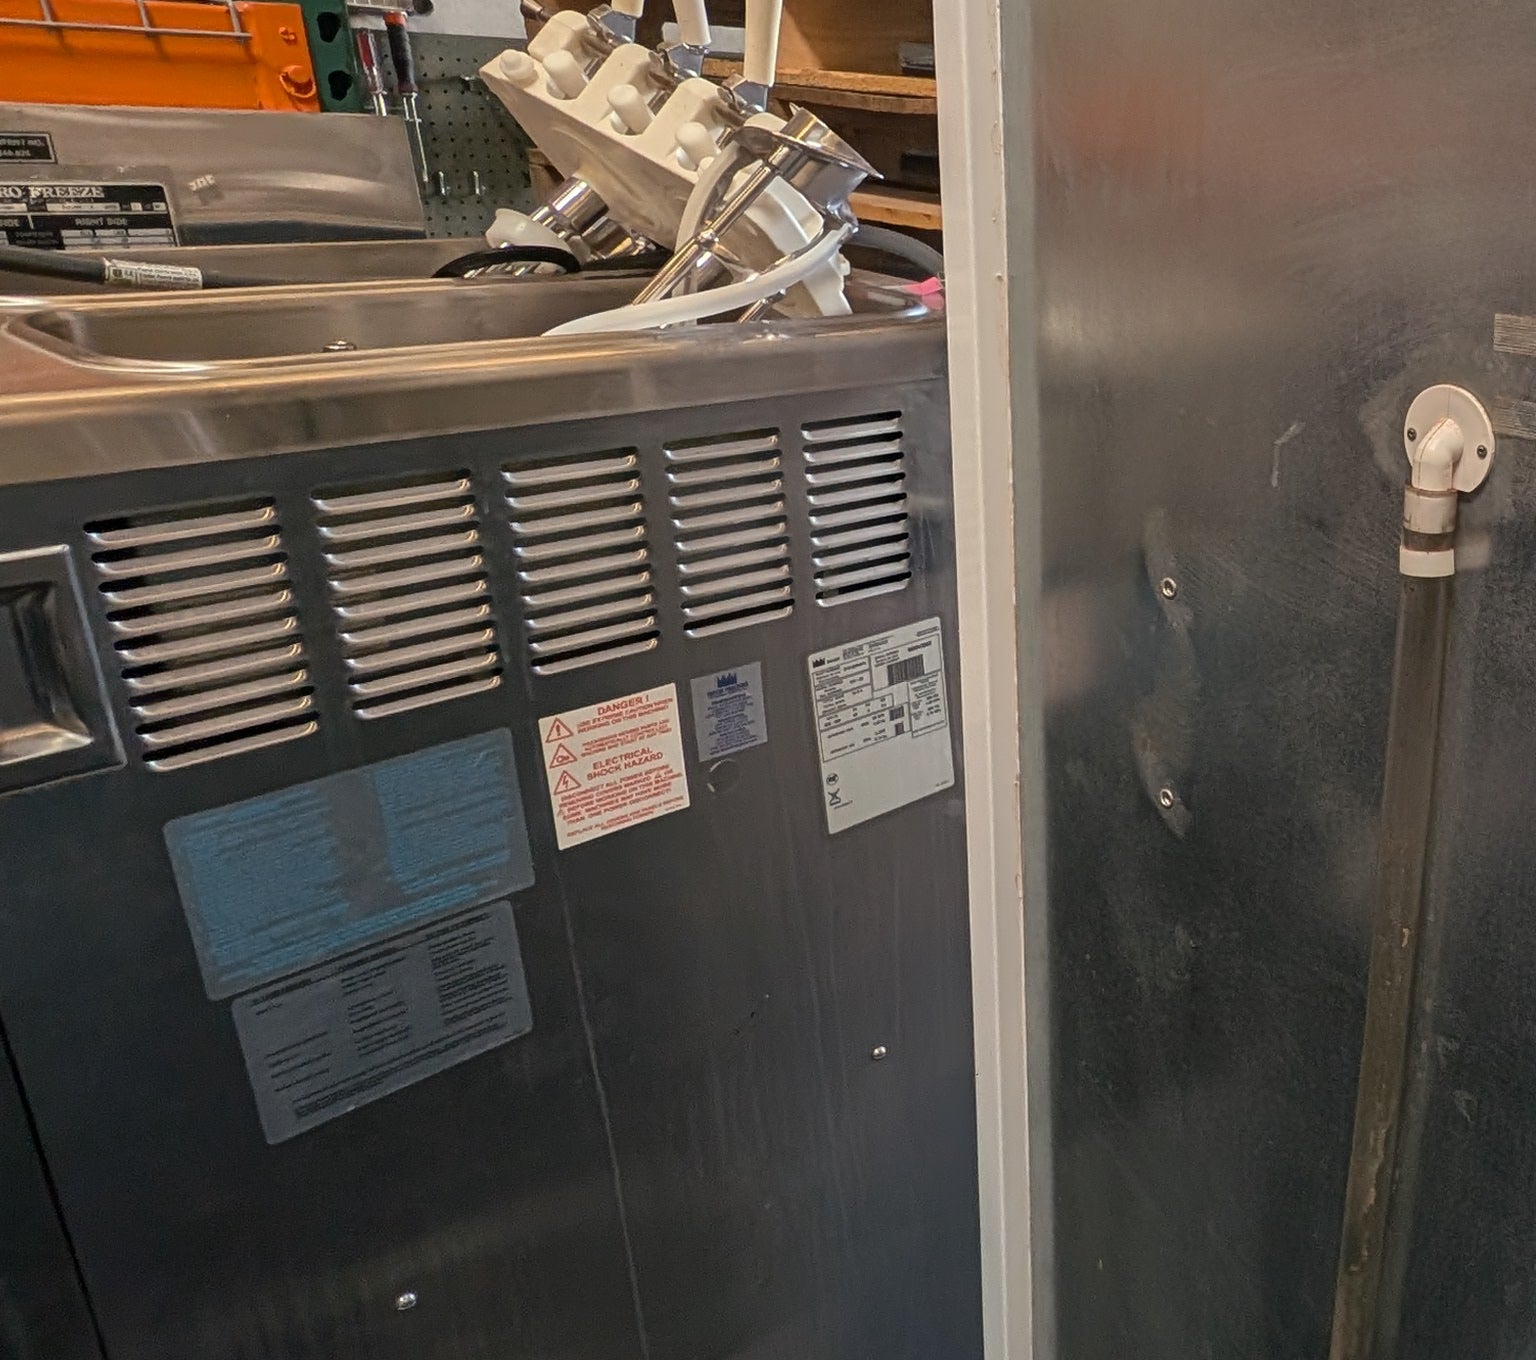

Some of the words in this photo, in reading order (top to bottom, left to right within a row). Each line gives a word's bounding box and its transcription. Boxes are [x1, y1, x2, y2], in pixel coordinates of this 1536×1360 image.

[29, 186, 105, 198] FREEZE
[597, 696, 643, 715] DANGER
[587, 766, 621, 780] SHOCK
[624, 752, 663, 769] HAZARD
[593, 747, 653, 770] ELECTRICAL
